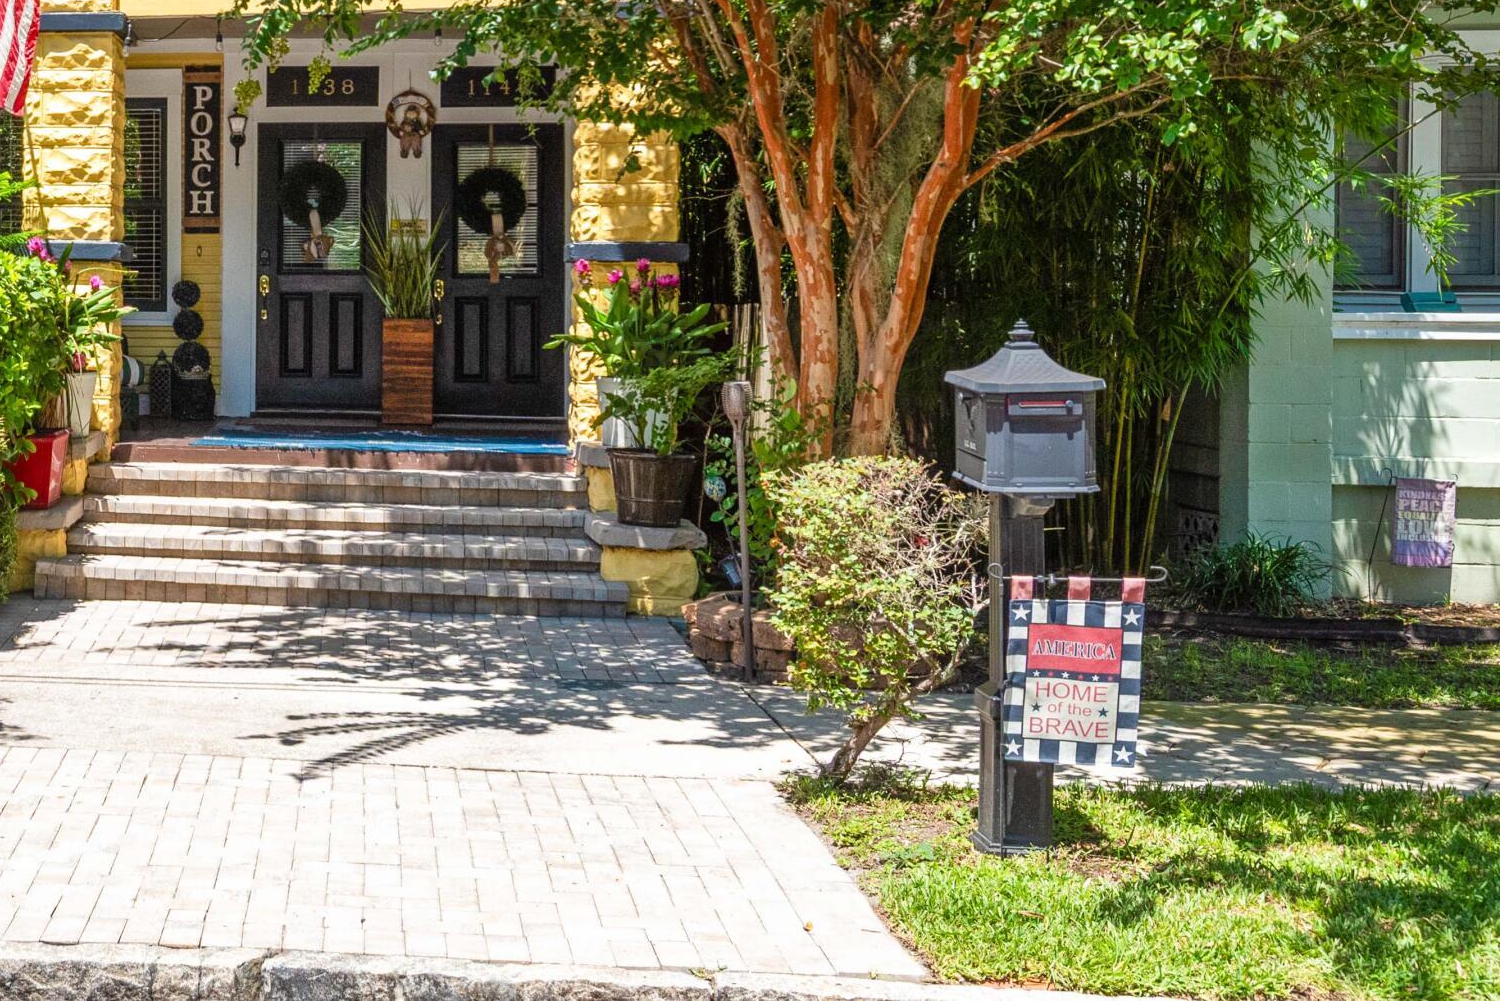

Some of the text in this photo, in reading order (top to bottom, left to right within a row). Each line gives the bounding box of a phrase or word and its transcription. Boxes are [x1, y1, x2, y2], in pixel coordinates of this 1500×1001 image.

[291, 79, 355, 95] 138
[468, 79, 524, 96] 114
[189, 85, 215, 215] PORCH
[1031, 638, 1117, 660] AMERICA
[1035, 681, 1108, 703] HOME
[1047, 702, 1092, 717] of the
[1029, 717, 1109, 738] BRAVE
